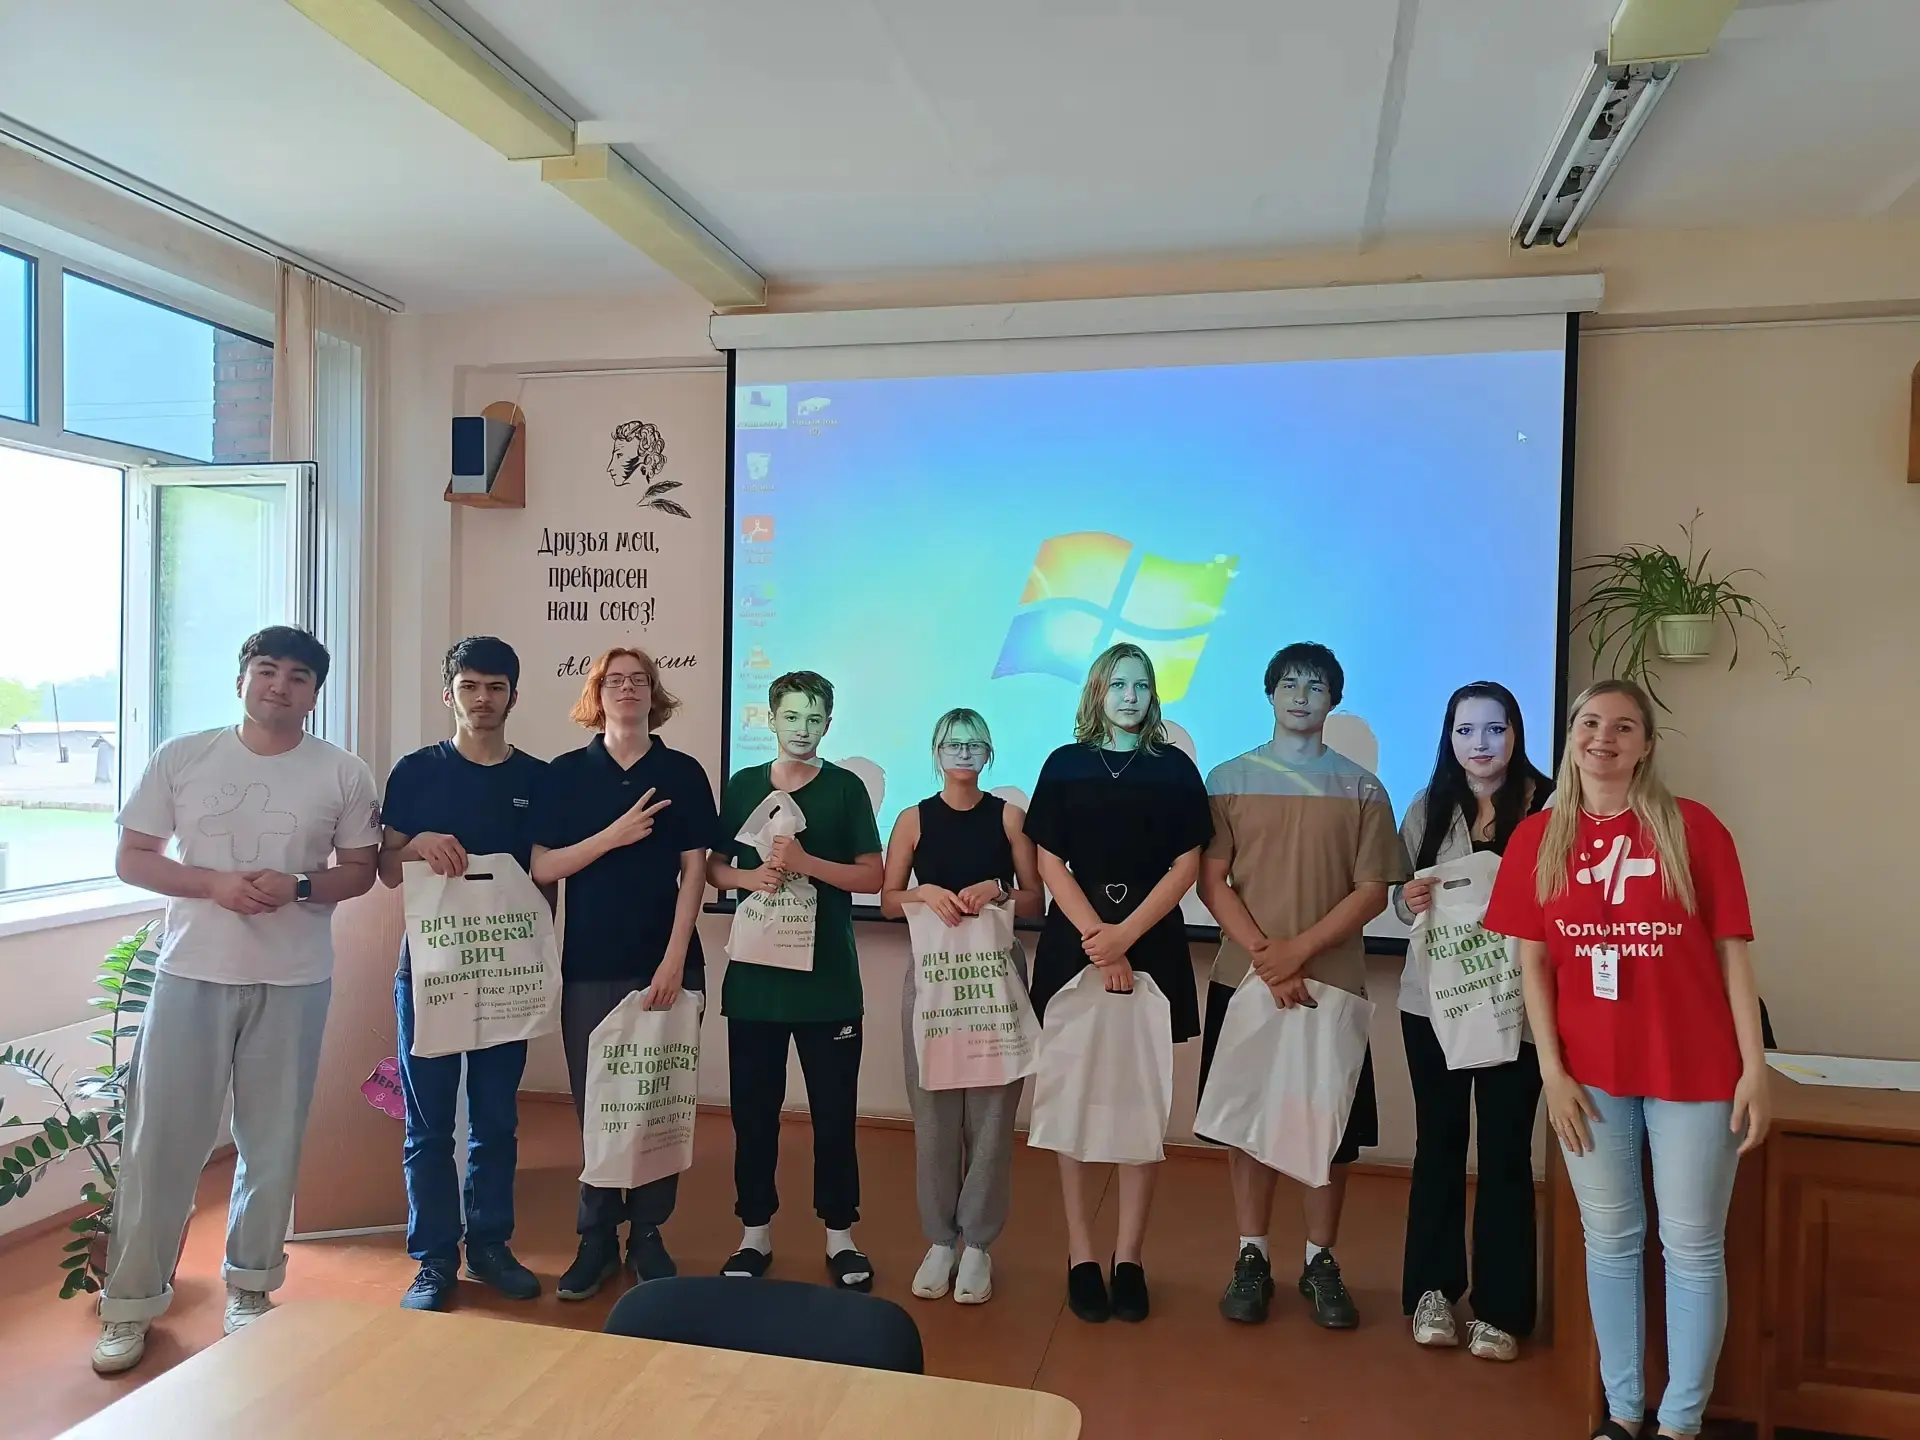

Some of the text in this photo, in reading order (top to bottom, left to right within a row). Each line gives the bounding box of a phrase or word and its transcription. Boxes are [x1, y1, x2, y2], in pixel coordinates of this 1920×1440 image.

[538, 528, 660, 556] Друзья мои,
[548, 566, 648, 592] прекрасен
[547, 597, 655, 625] наш союз!
[655, 654, 697, 669] кин
[421, 911, 539, 934] ВИЧ не меняет
[781, 914, 809, 923] тоже
[428, 920, 534, 949] человека!
[1454, 922, 1473, 937] не
[460, 946, 505, 966] ВИЧ
[922, 951, 950, 967] ВИЧ
[955, 952, 972, 963] не
[1460, 946, 1510, 976] ВИЧ
[424, 961, 544, 988] положительный
[1435, 966, 1522, 1001] положитель
[426, 991, 456, 1006] друг
[477, 985, 505, 996] тоже
[508, 980, 543, 995] друг!
[953, 983, 995, 1001] ВИЧ
[1443, 1003, 1470, 1019] друг
[1489, 987, 1521, 1005] тоже
[925, 1026, 951, 1039] друг
[968, 1021, 997, 1033] тоже
[603, 1043, 699, 1059] ВИЧ не меняе
[607, 1055, 698, 1075] человека!
[637, 1075, 670, 1096] ВИЧ
[600, 1095, 696, 1113] положительный
[602, 1121, 630, 1133] друг
[668, 1111, 692, 1124] друг!
